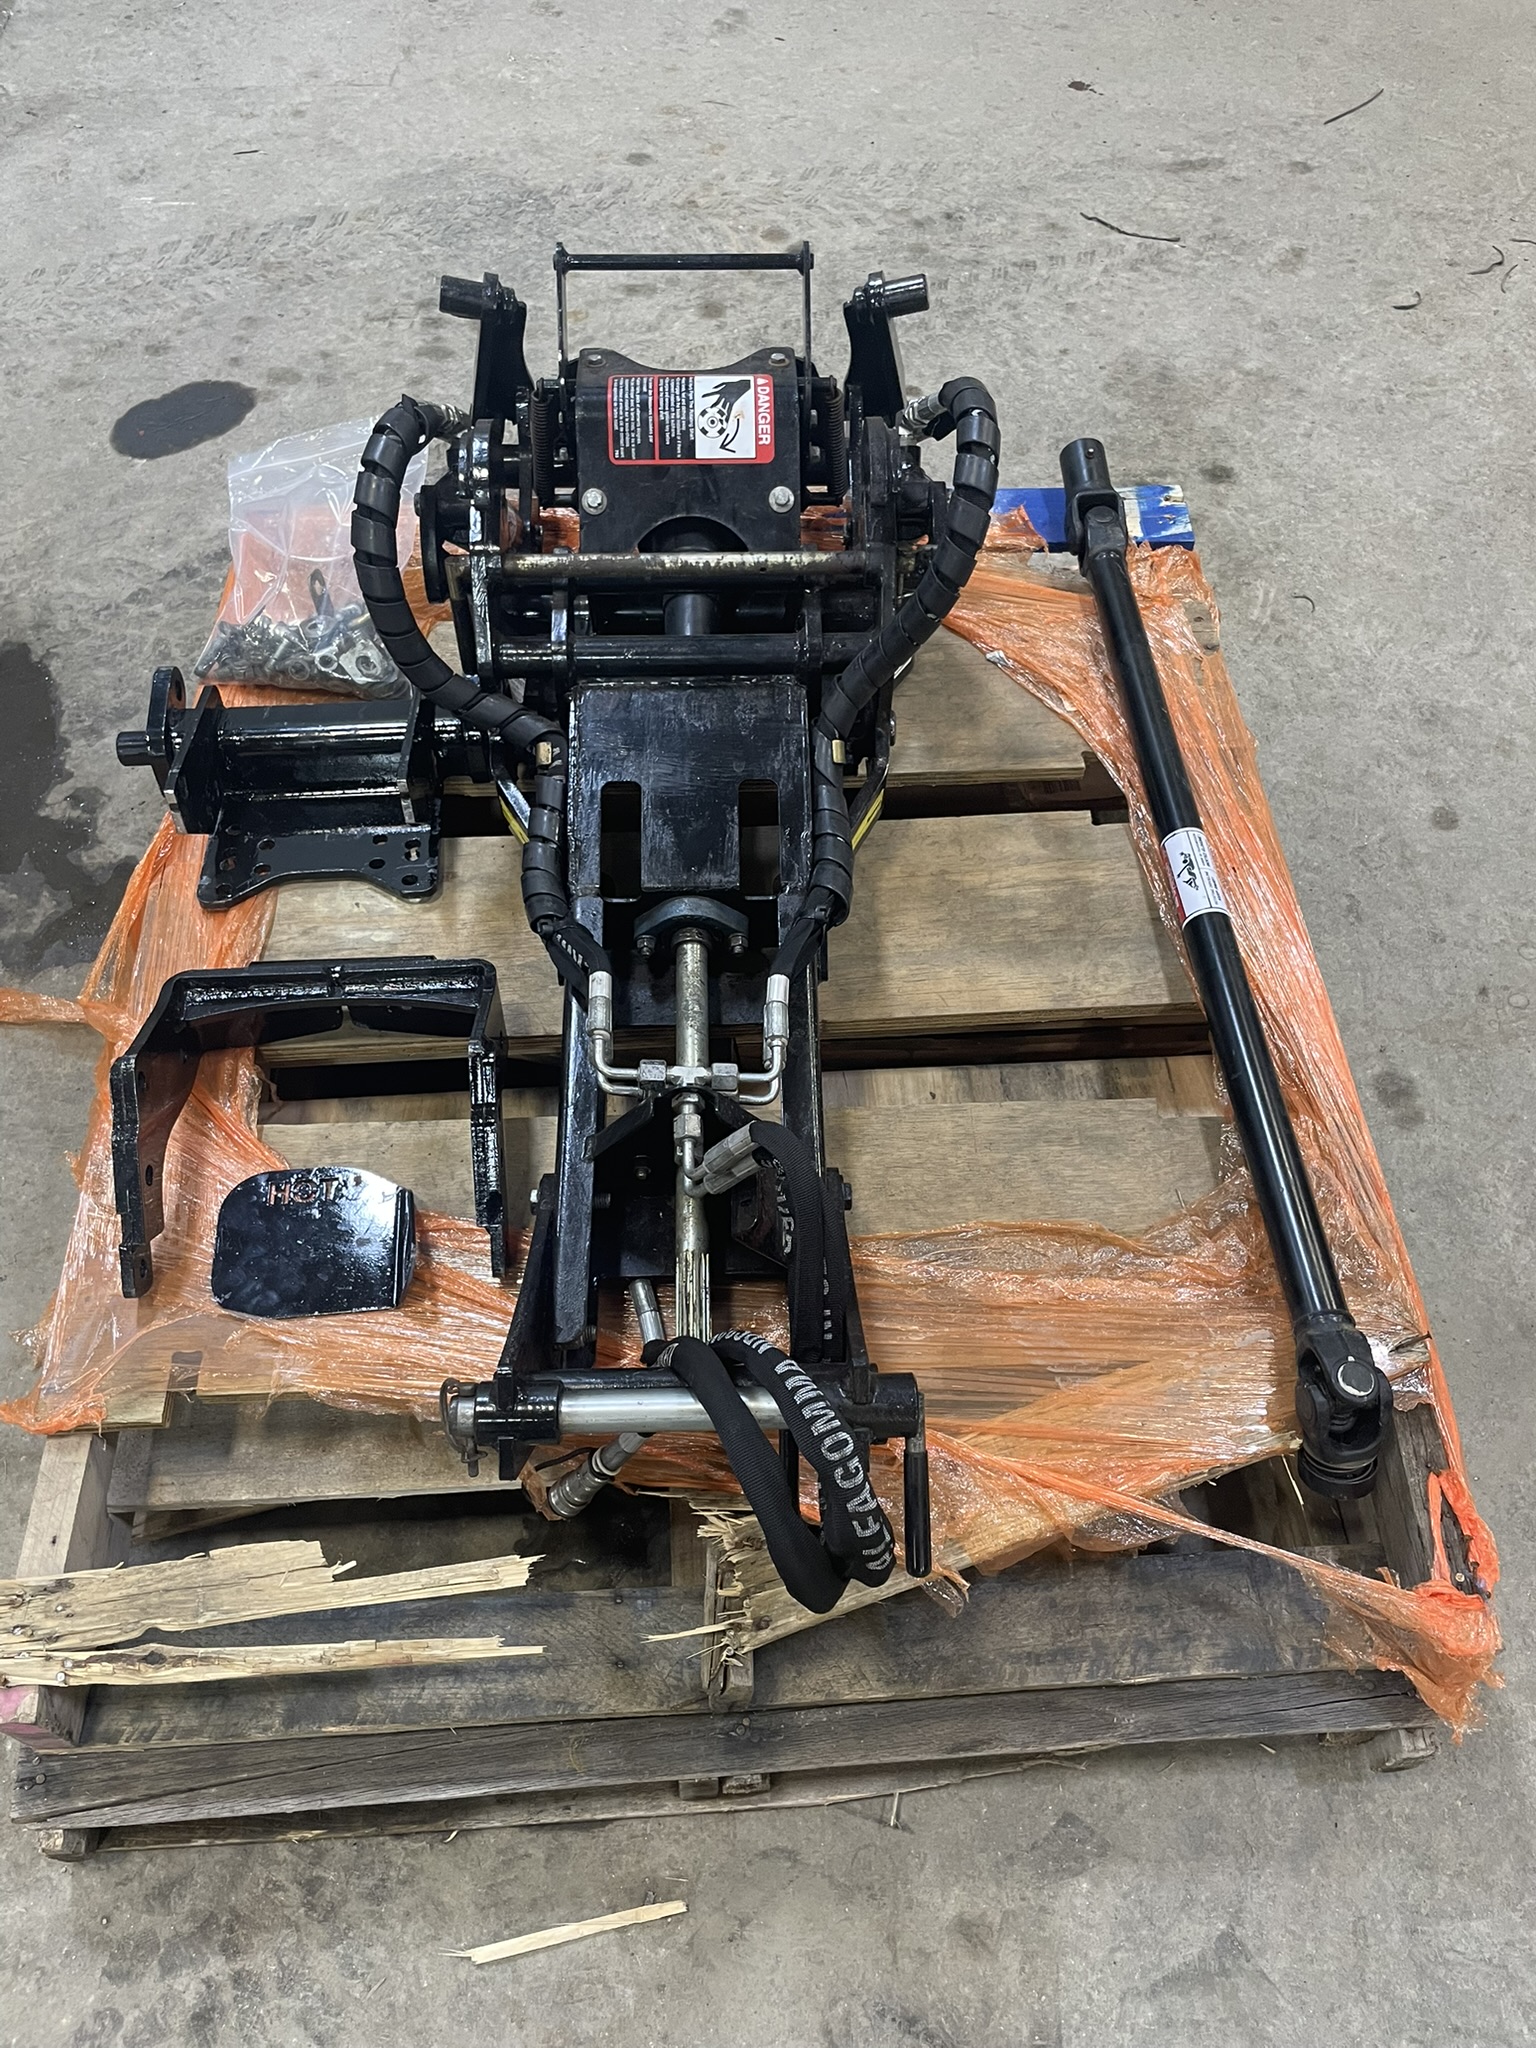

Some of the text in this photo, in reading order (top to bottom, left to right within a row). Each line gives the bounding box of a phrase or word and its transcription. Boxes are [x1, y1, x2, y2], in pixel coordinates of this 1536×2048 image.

[758, 386, 770, 444] DANGER
[266, 1176, 340, 1207] HOT
[774, 1358, 895, 1571] ALFAGOMMA
